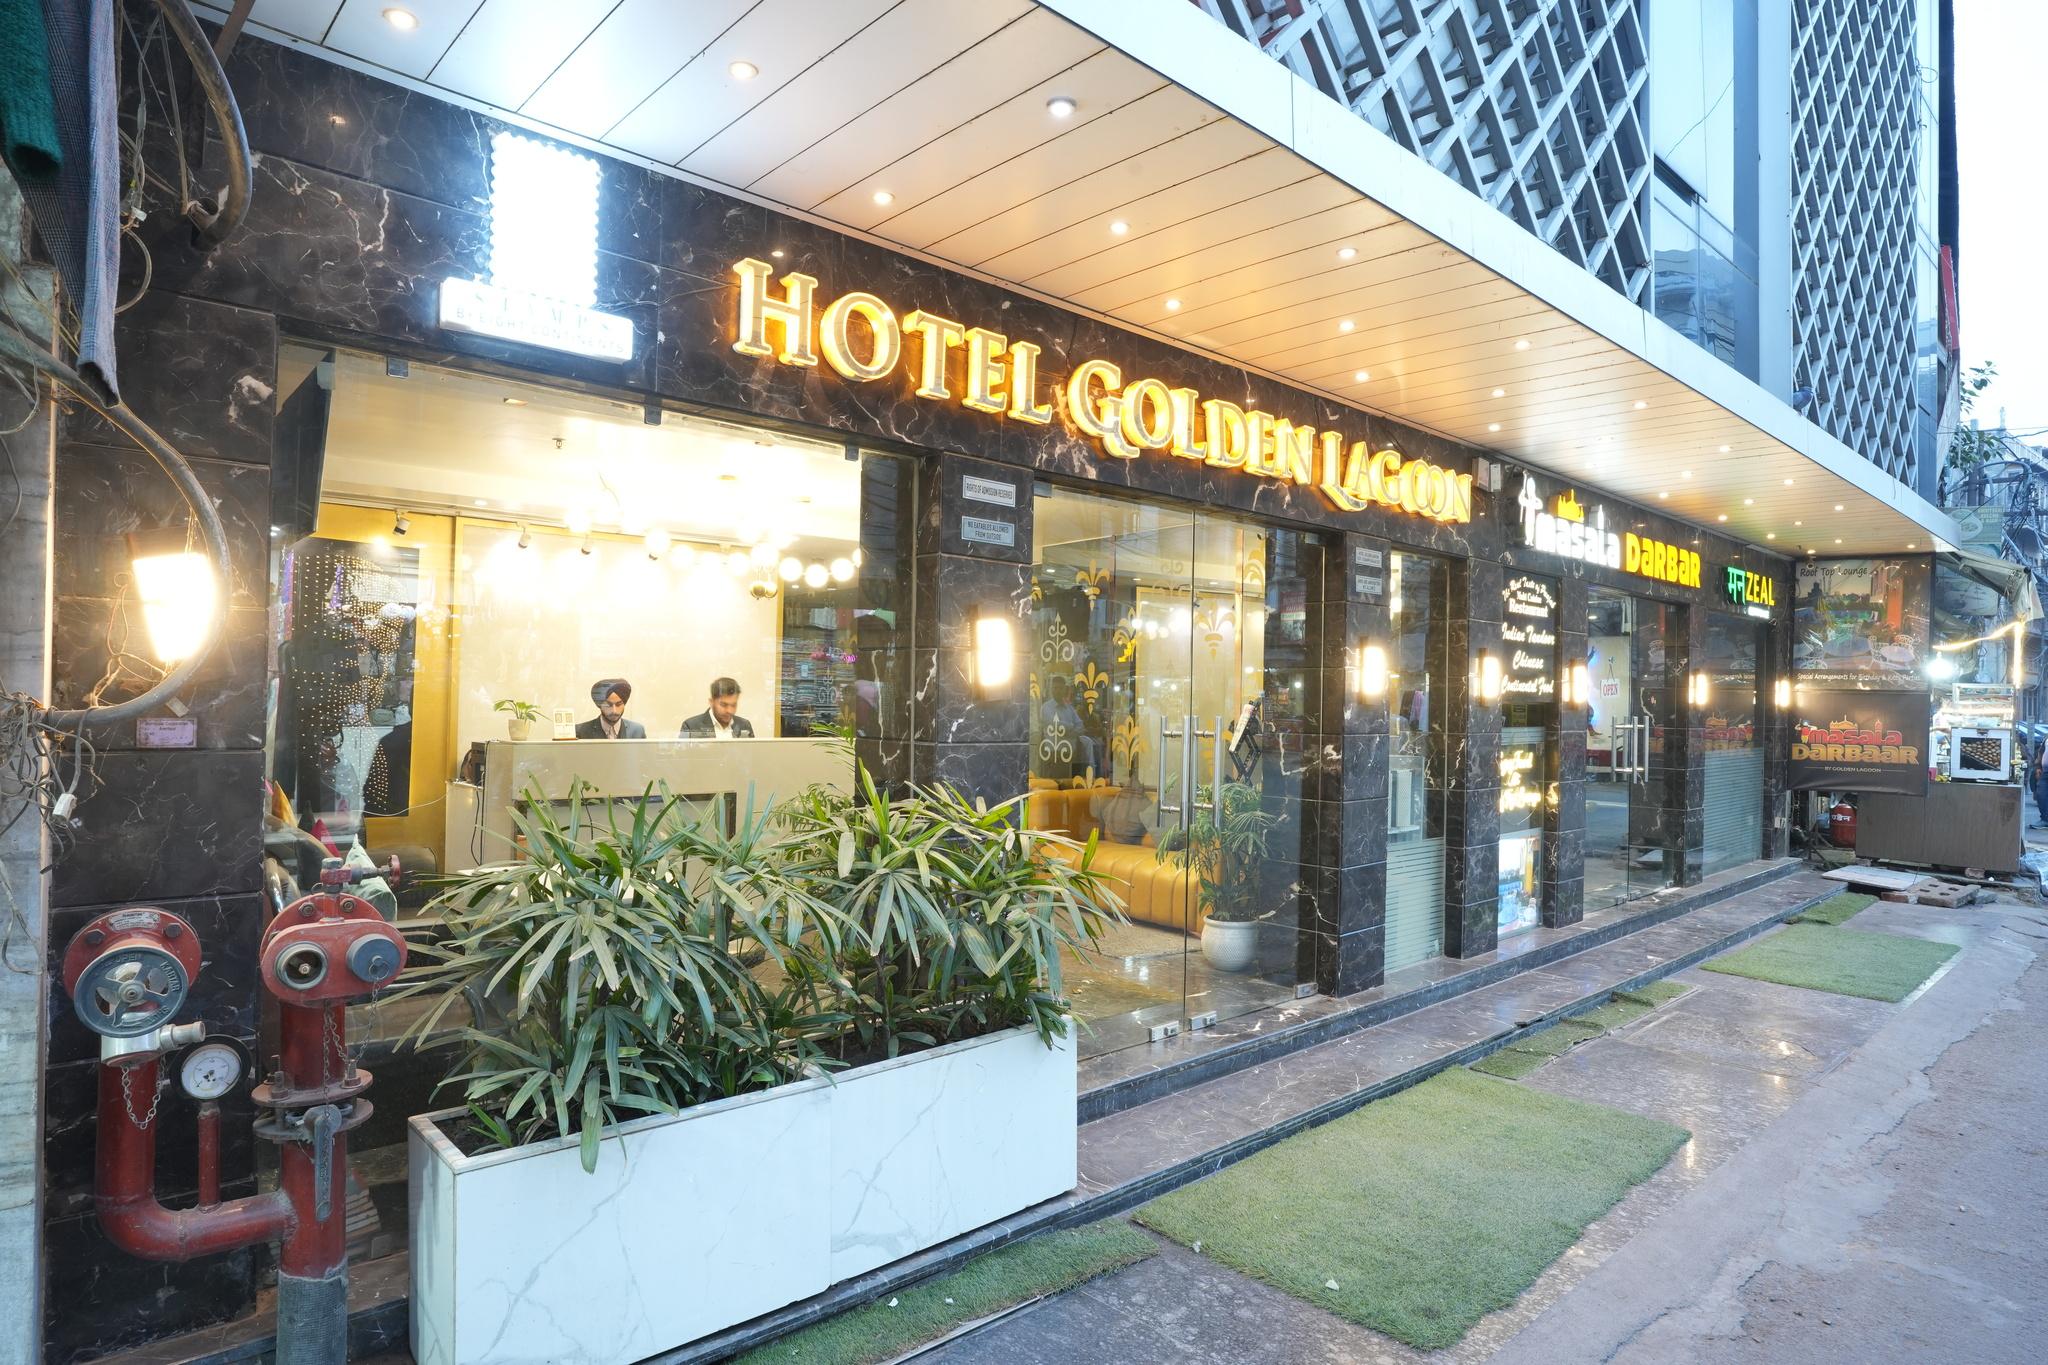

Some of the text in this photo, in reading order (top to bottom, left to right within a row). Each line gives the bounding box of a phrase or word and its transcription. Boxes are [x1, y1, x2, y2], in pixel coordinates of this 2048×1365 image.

[733, 257, 1474, 524] HOTEL GOLDEN LAGOON
[1800, 567, 1818, 577] Roof
[1821, 567, 1836, 577] Top
[1746, 571, 1775, 606] ZEAL
[1509, 597, 1548, 617] Restaurant
[1502, 622, 1526, 642] Indian
[1513, 650, 1544, 669] Chinese
[1538, 676, 1554, 695] Food
[1603, 683, 1618, 696] OPEN
